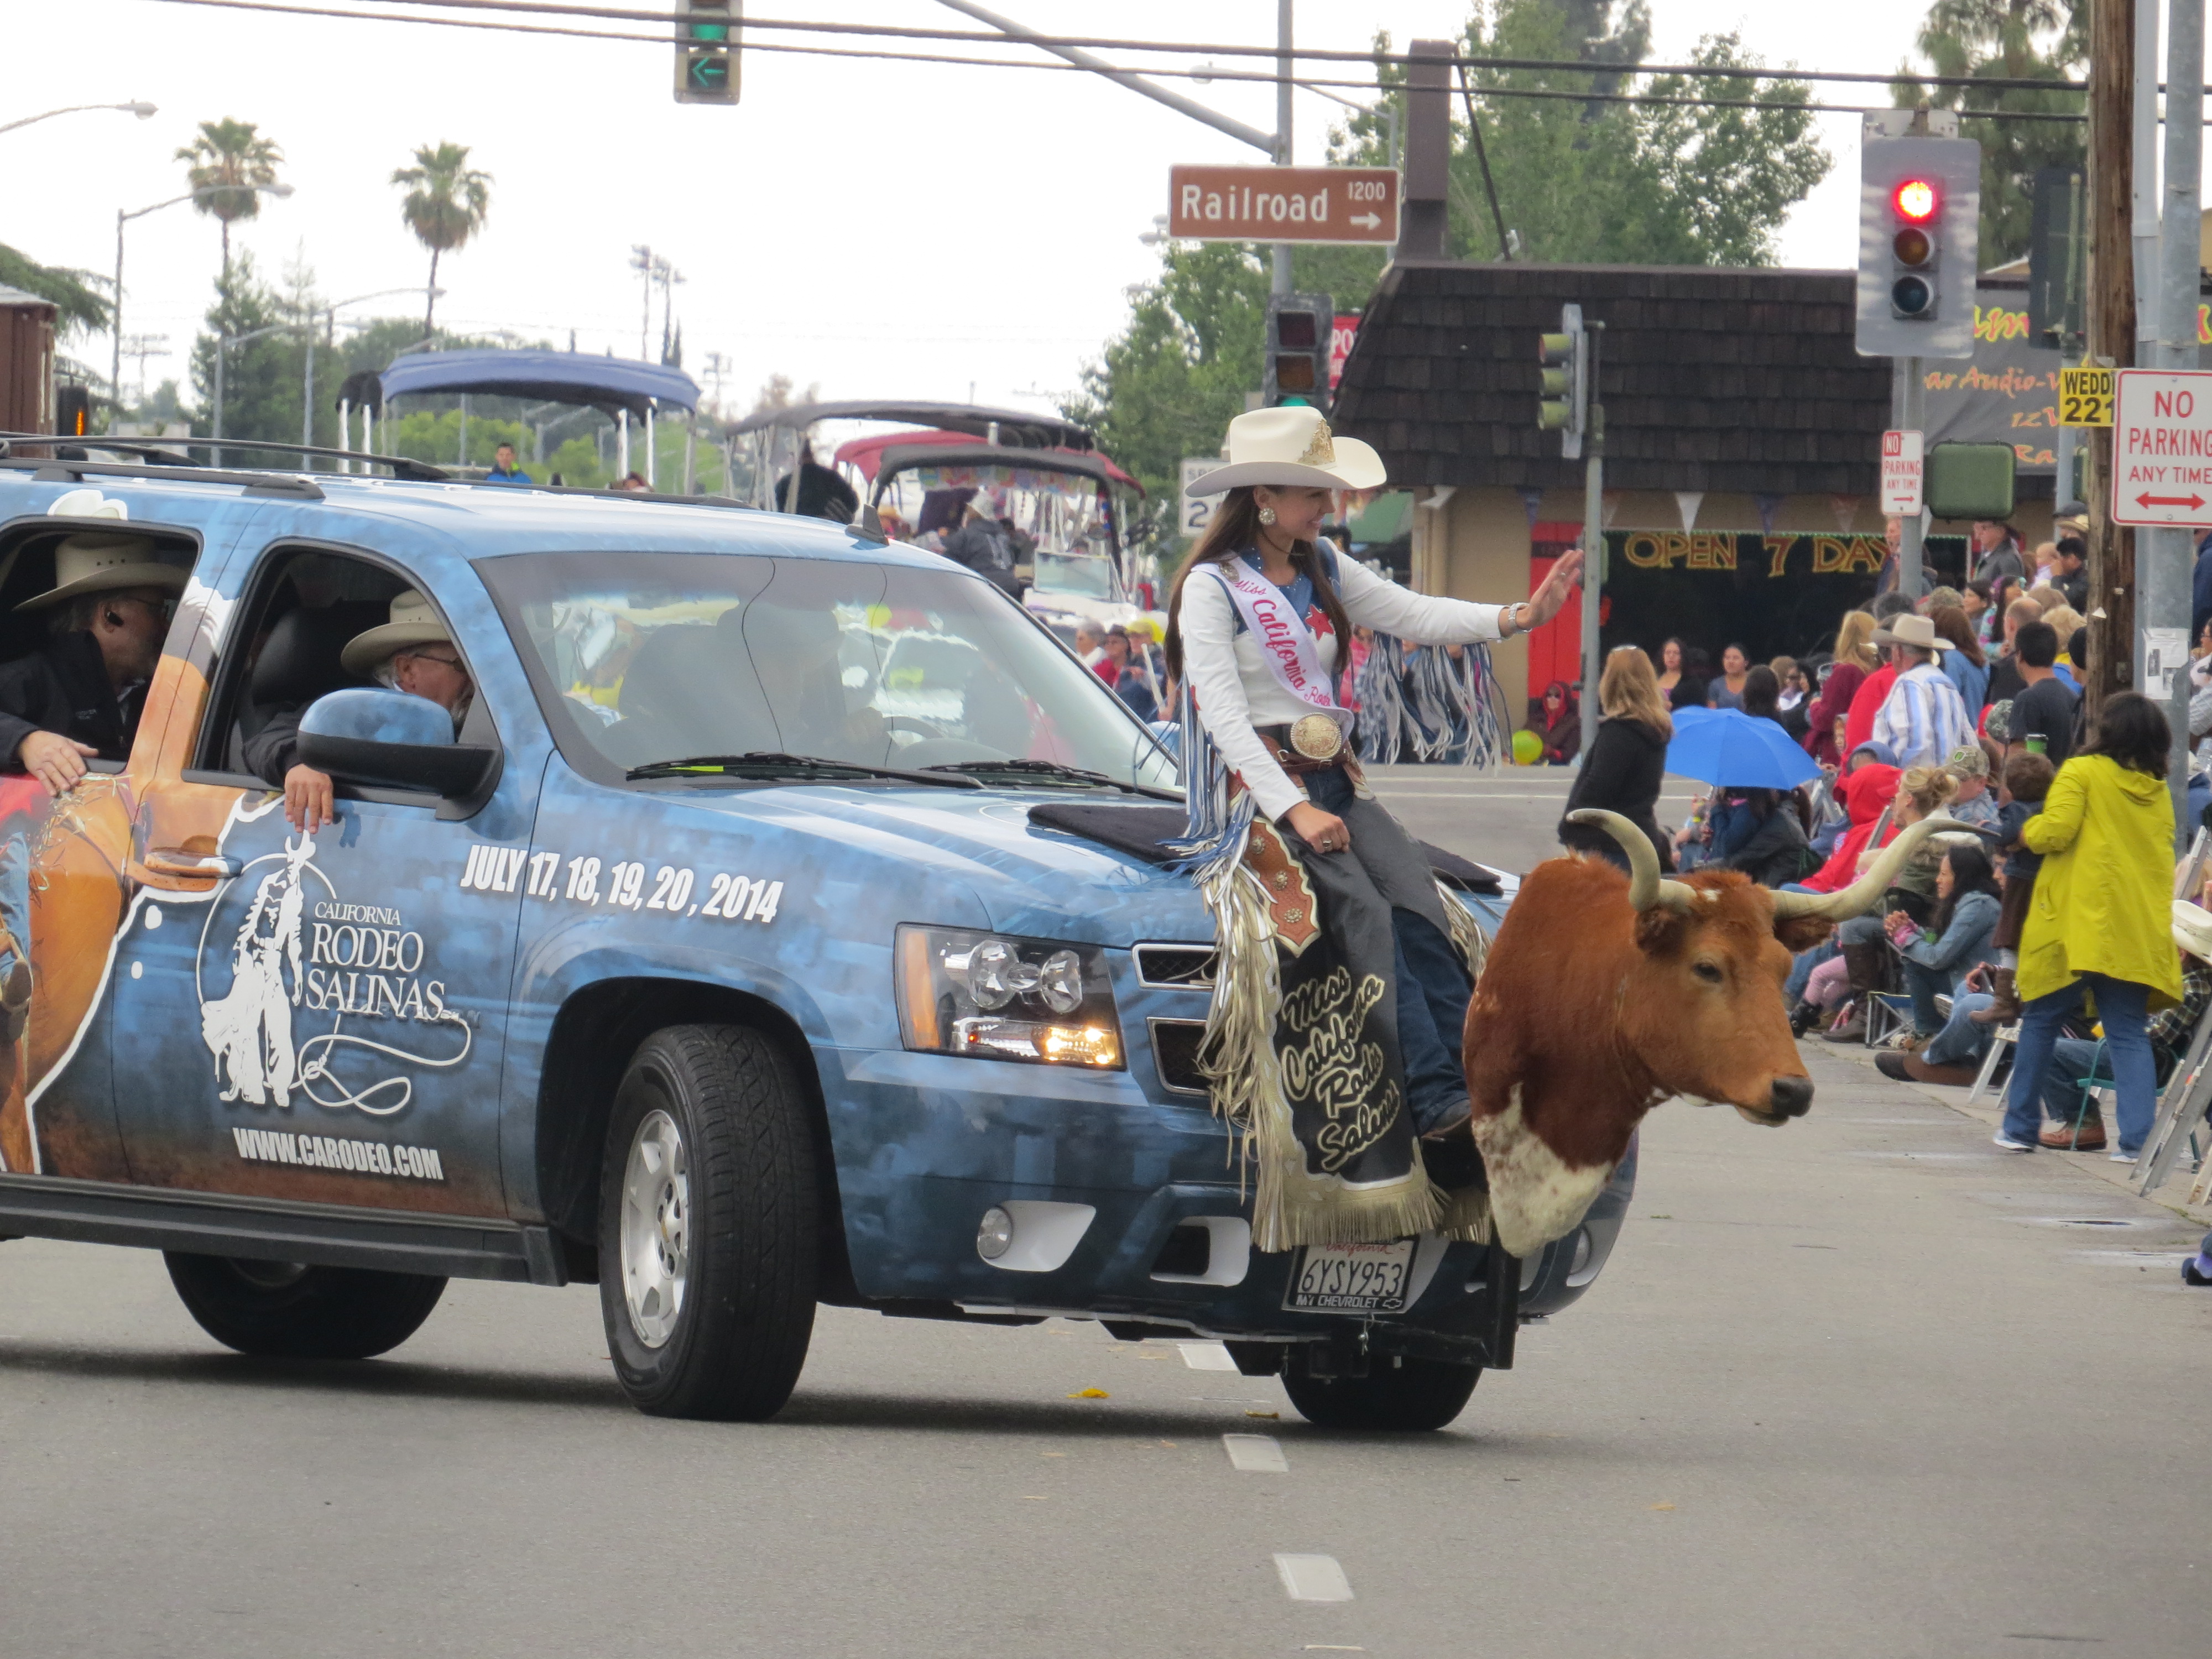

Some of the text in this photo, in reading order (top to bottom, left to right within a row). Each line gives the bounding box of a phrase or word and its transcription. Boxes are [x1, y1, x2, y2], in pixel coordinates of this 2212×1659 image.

[1181, 184, 1328, 222] Railroad
[1347, 181, 1386, 201] 1200
[1329, 328, 1357, 355] PO
[1924, 371, 1958, 389] ar
[2064, 371, 2115, 395] WEDD
[2154, 390, 2194, 418] NO
[1886, 435, 1899, 453] NO
[2128, 427, 2212, 457] PARKING
[1884, 460, 1922, 476] PARKING
[2128, 465, 2212, 484] ANY TIME
[1887, 479, 1918, 490] ANY TIME
[1624, 532, 1891, 577] OPEN 7 DAY
[1234, 580, 1267, 596] Miss
[1252, 599, 1307, 691] California
[460, 844, 528, 893] JULY
[527, 852, 561, 902] 17,
[565, 856, 602, 906] 18,
[607, 861, 645, 911] 19,
[701, 872, 785, 924] 2014
[315, 901, 402, 926] CALIFORNIA
[310, 922, 424, 973] RODEO
[305, 968, 445, 1021] SALINAS
[1281, 966, 1352, 1032] Miss
[232, 1127, 444, 1181] WWW.CARODEO.COM
[1301, 1259, 1403, 1296] 6YSY953
[1317, 1295, 1380, 1308] CHEVROLET
